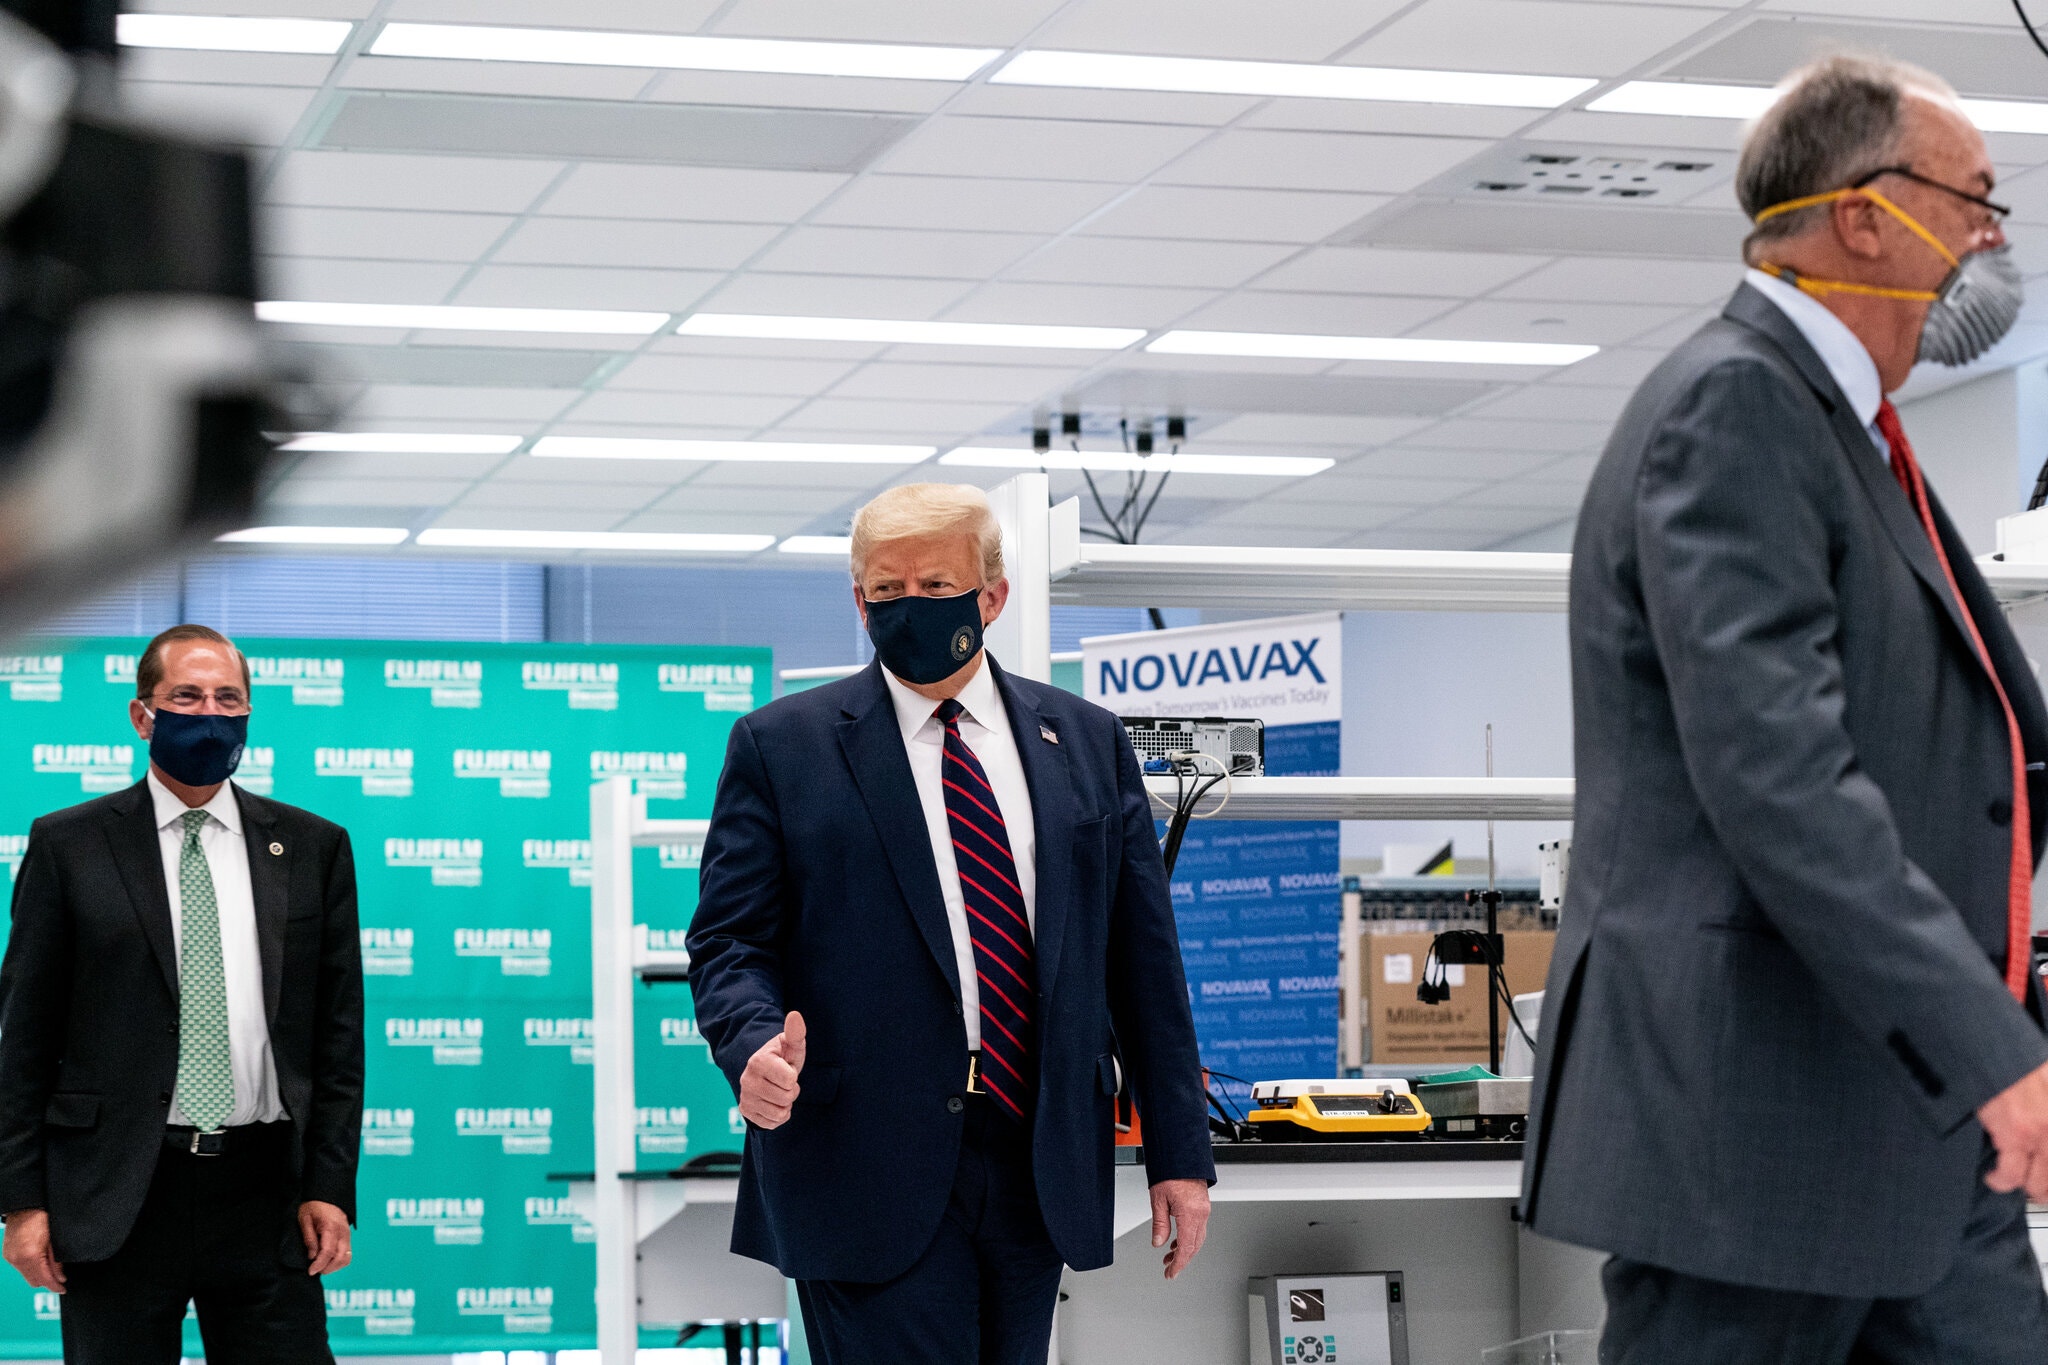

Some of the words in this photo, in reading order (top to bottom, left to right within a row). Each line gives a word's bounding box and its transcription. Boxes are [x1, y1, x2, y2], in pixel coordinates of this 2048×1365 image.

[385, 660, 482, 680] FUJIFILM
[522, 662, 618, 682] FUJIFILM
[658, 665, 753, 685] FUJIFILM
[1100, 637, 1326, 696] NOVAVAX
[1231, 693, 1286, 710] Vaccines
[1290, 687, 1329, 705] Today
[33, 744, 133, 765] FUJIFILM
[315, 747, 413, 768] FUJIFILM
[453, 750, 551, 770] FUJIFILM
[591, 752, 687, 772] FUJIFILM
[385, 838, 482, 858] FUJIFILM
[523, 840, 591, 859] FUJIFI
[1202, 877, 1271, 896] NOVAVAX
[1279, 872, 1340, 889] NOVAVA
[454, 928, 551, 948] FUJIFILM
[1201, 978, 1271, 997] NOVAVAX
[1279, 974, 1339, 991] NOVAVA
[386, 1019, 483, 1039] FUJIFILM
[524, 1019, 594, 1038] FUJIFI
[456, 1108, 552, 1128] FUJIFILM
[387, 1199, 483, 1219] FUJIFILM
[457, 1288, 553, 1308] FUJIFILM
